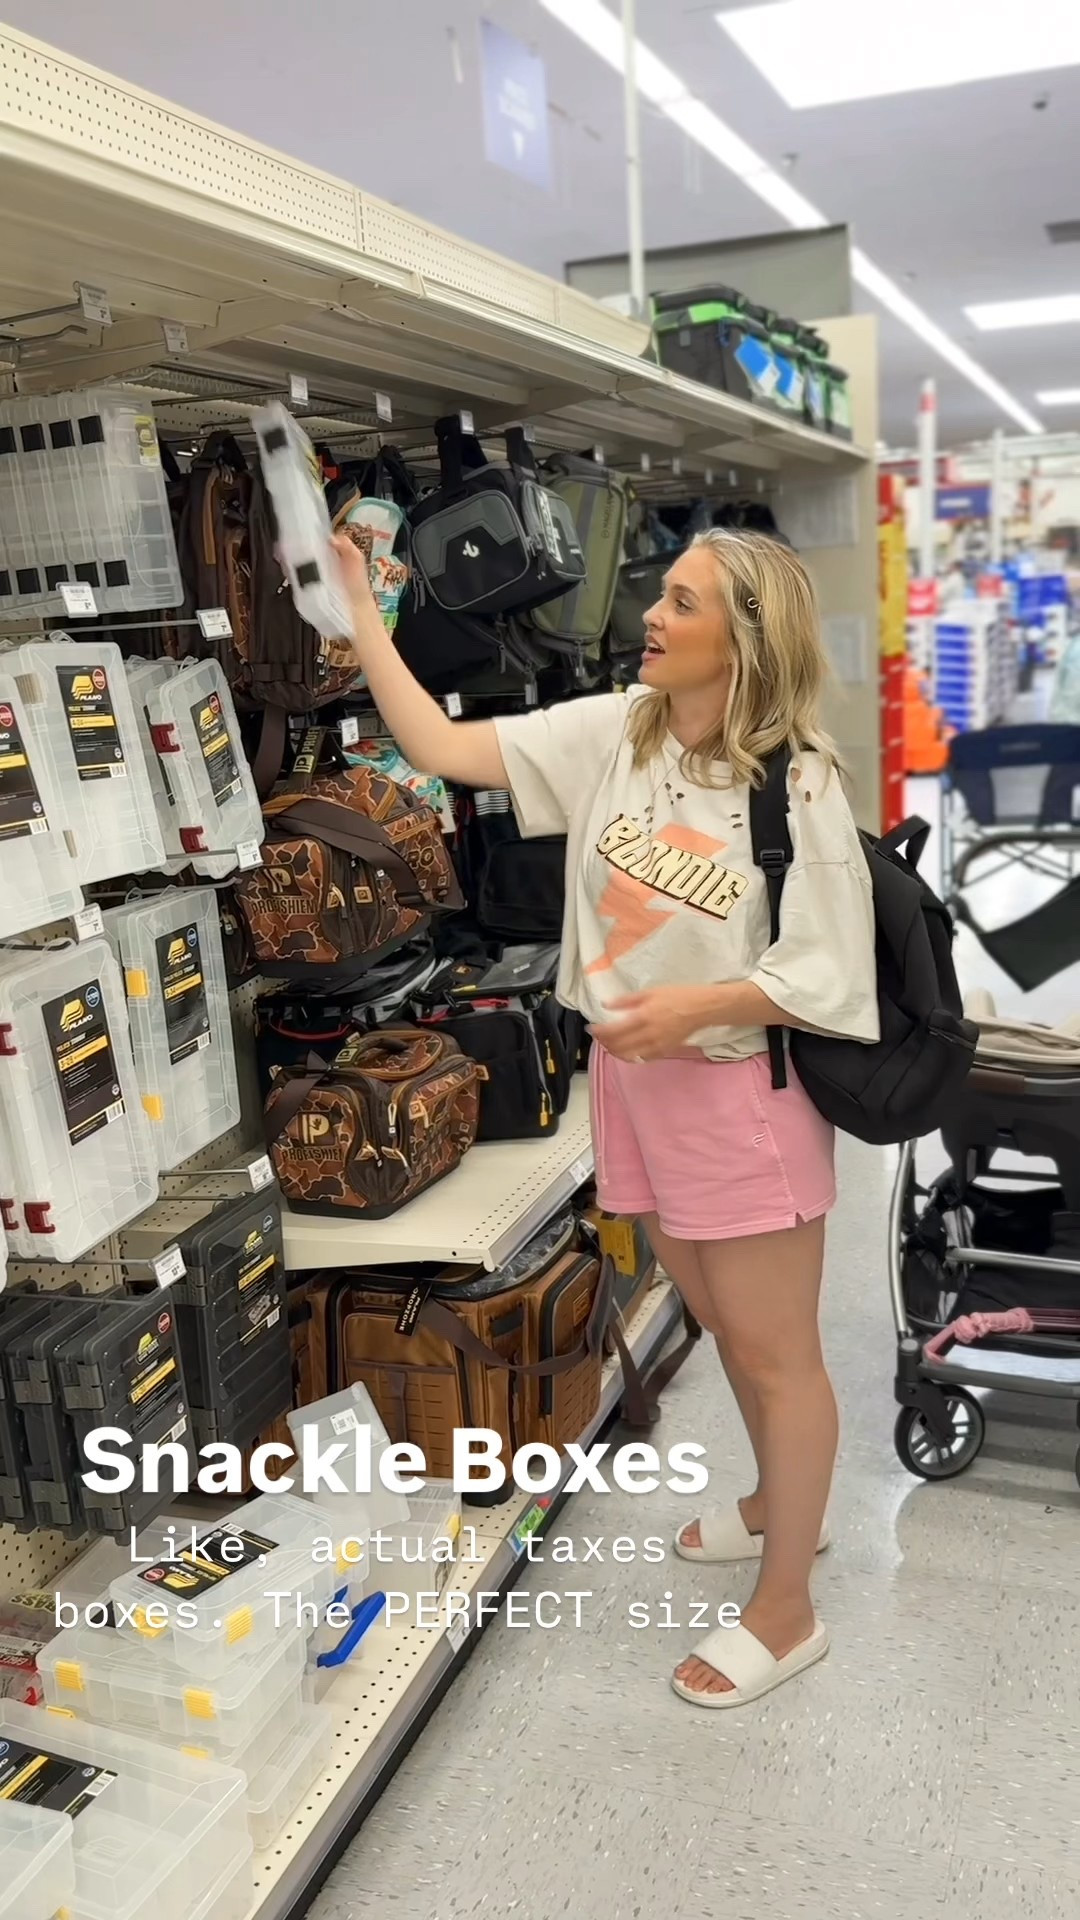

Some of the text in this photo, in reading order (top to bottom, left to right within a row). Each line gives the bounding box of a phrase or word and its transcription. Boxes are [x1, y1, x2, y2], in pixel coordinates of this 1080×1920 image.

[595, 813, 749, 921] BLONDIE
[67, 1014, 94, 1031] PLANO
[399, 1287, 419, 1331] DROPZONE
